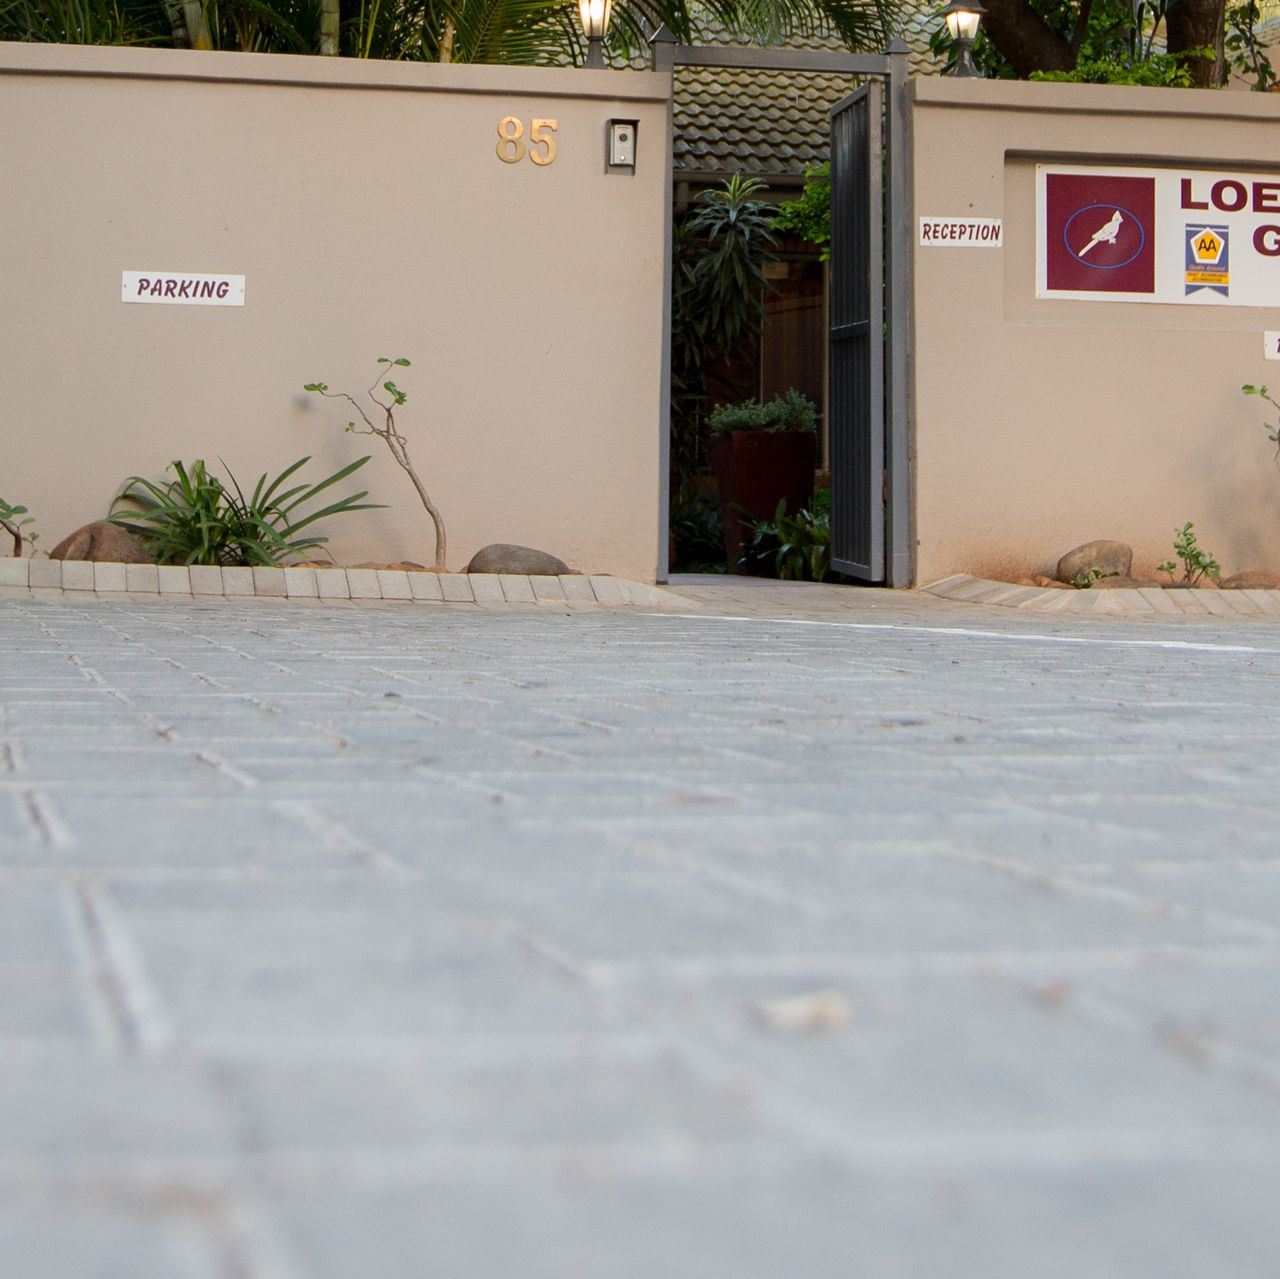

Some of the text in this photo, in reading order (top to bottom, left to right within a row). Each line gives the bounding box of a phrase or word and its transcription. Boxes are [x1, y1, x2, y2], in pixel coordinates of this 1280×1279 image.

[496, 116, 558, 166] 85
[922, 223, 1001, 240] RECEPTION
[1198, 239, 1217, 251] AA
[137, 279, 230, 298] PARKING
